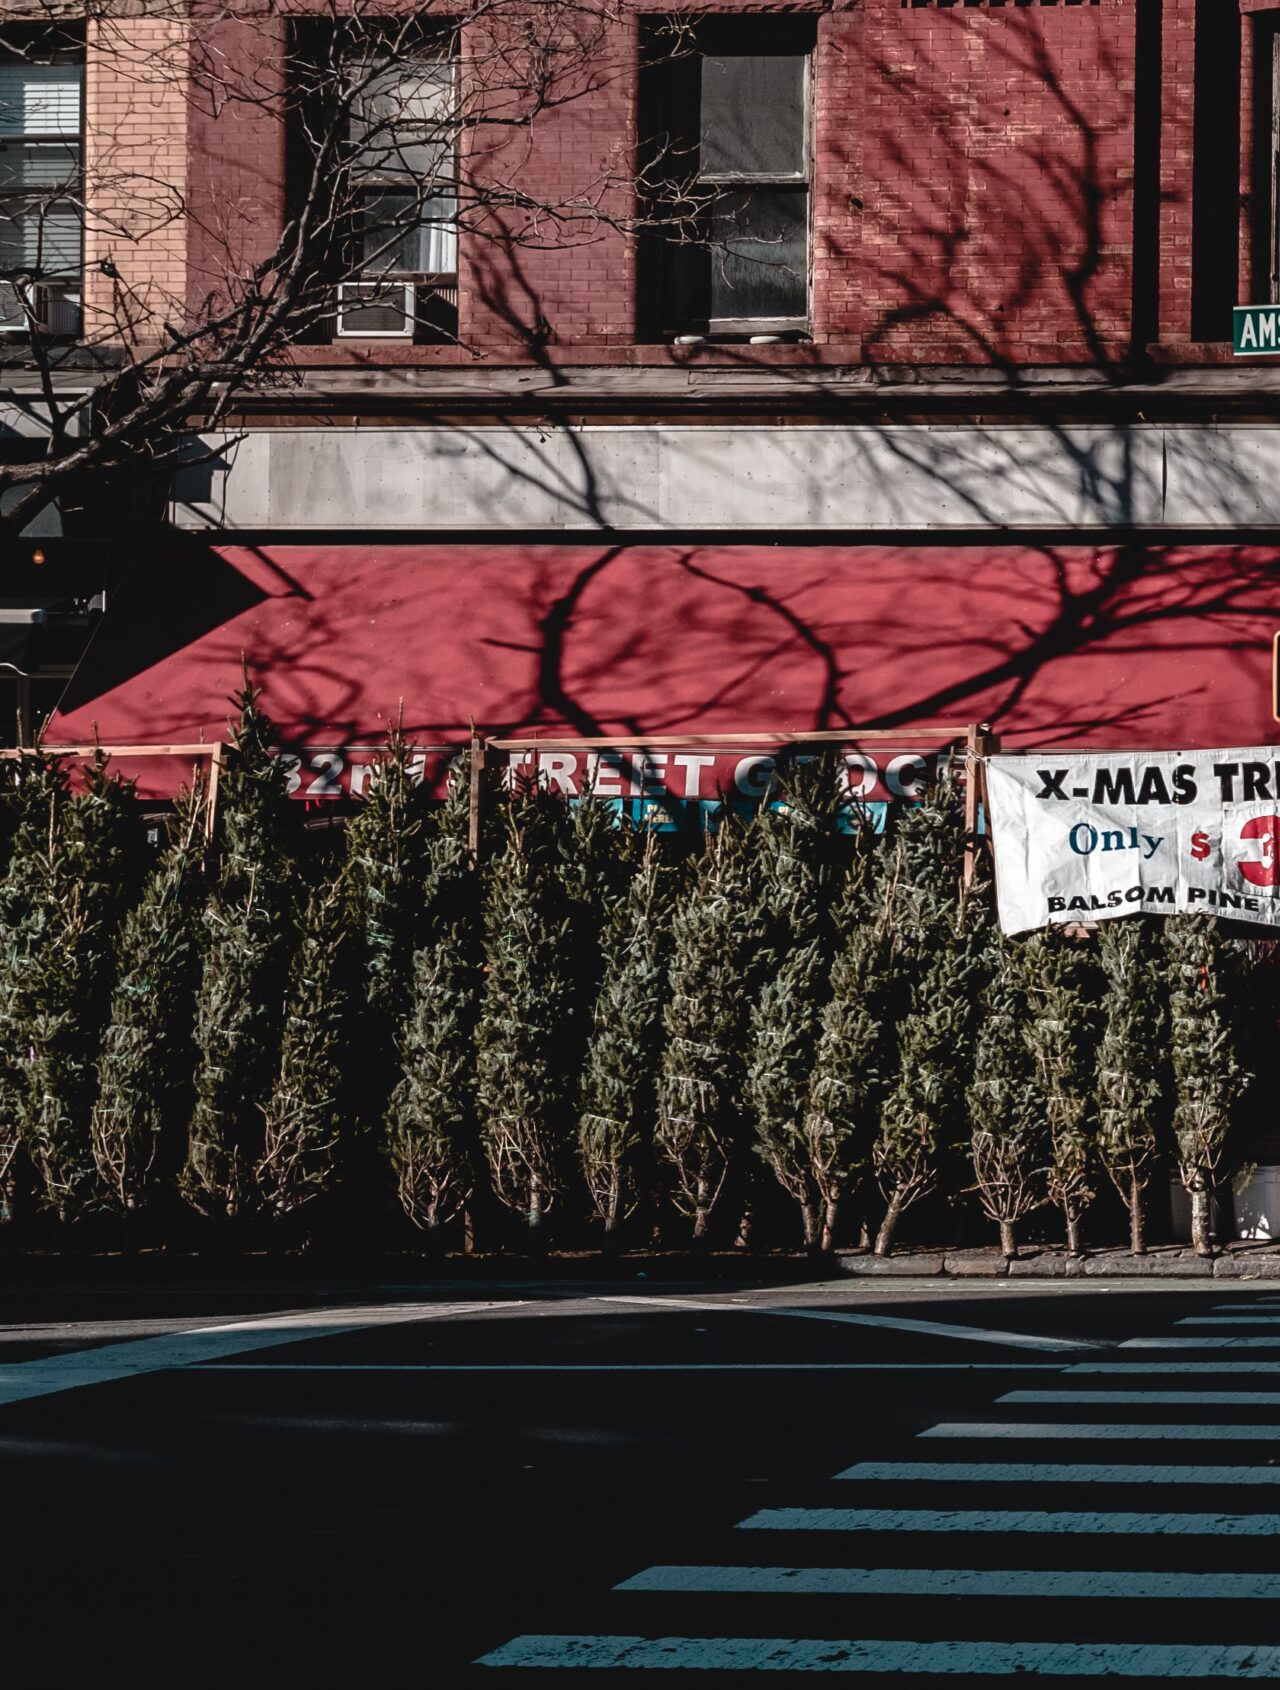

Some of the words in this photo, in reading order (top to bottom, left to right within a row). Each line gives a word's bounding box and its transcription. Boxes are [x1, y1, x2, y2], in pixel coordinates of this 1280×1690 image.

[1035, 764, 1198, 806] X-MAS
[1068, 822, 1165, 859] Only
[1190, 830, 1211, 861] $
[1047, 886, 1176, 913] BALSOM
[1187, 887, 1260, 912] PINE
